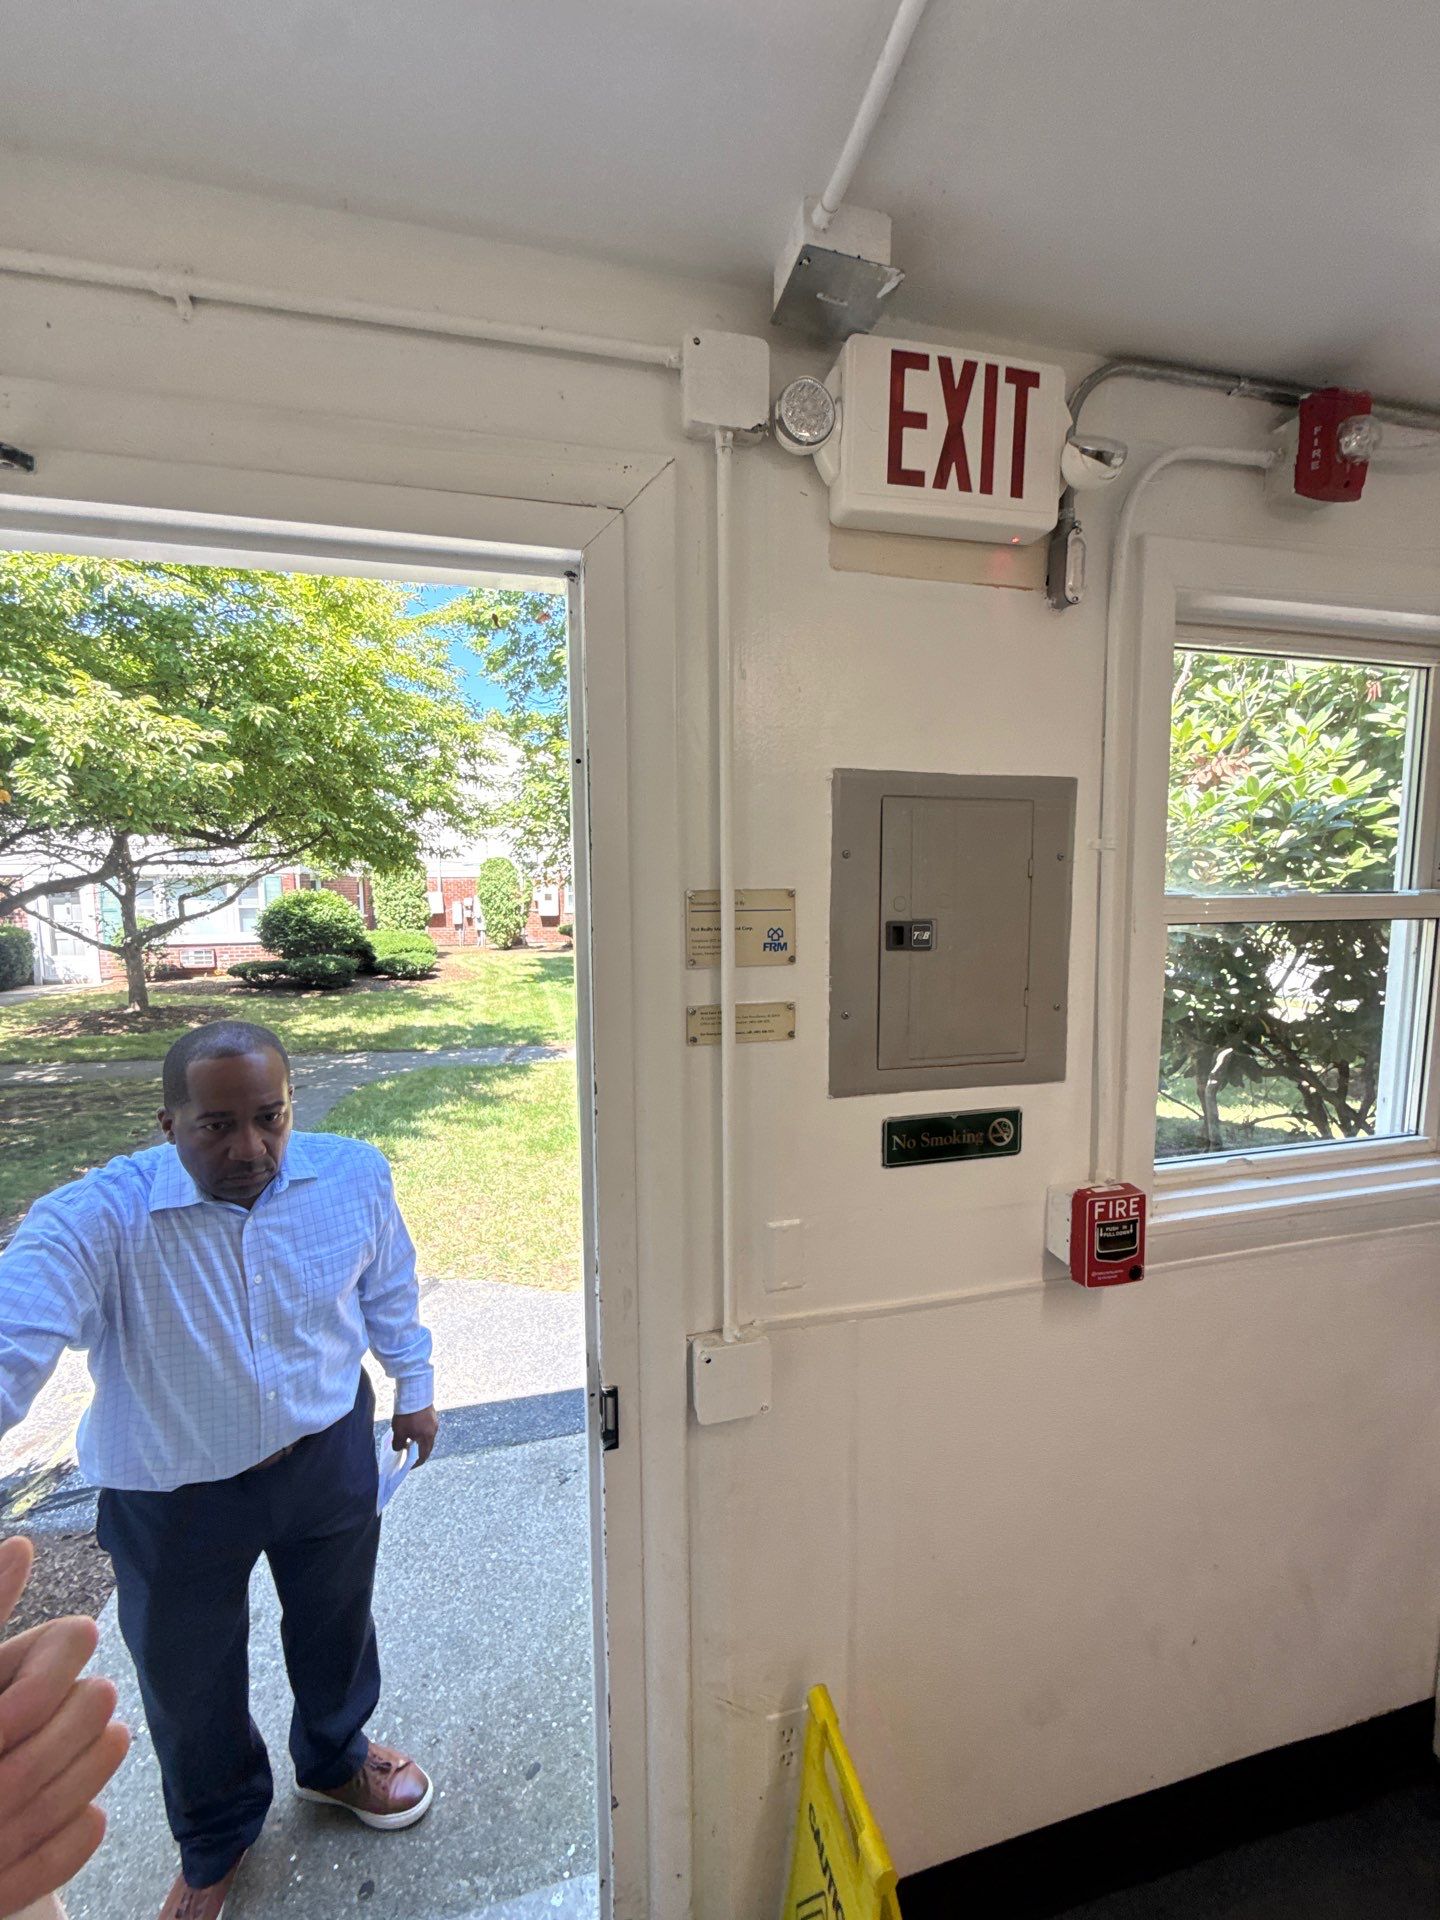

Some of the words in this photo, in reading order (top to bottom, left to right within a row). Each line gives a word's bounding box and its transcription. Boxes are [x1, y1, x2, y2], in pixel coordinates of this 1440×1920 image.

[887, 348, 1041, 499] EXIT
[1310, 425, 1322, 471] FIRE
[763, 942, 788, 952] FRM
[891, 1134, 917, 1151] No
[920, 1129, 984, 1148] Smoking
[1094, 1197, 1140, 1220] FIRE
